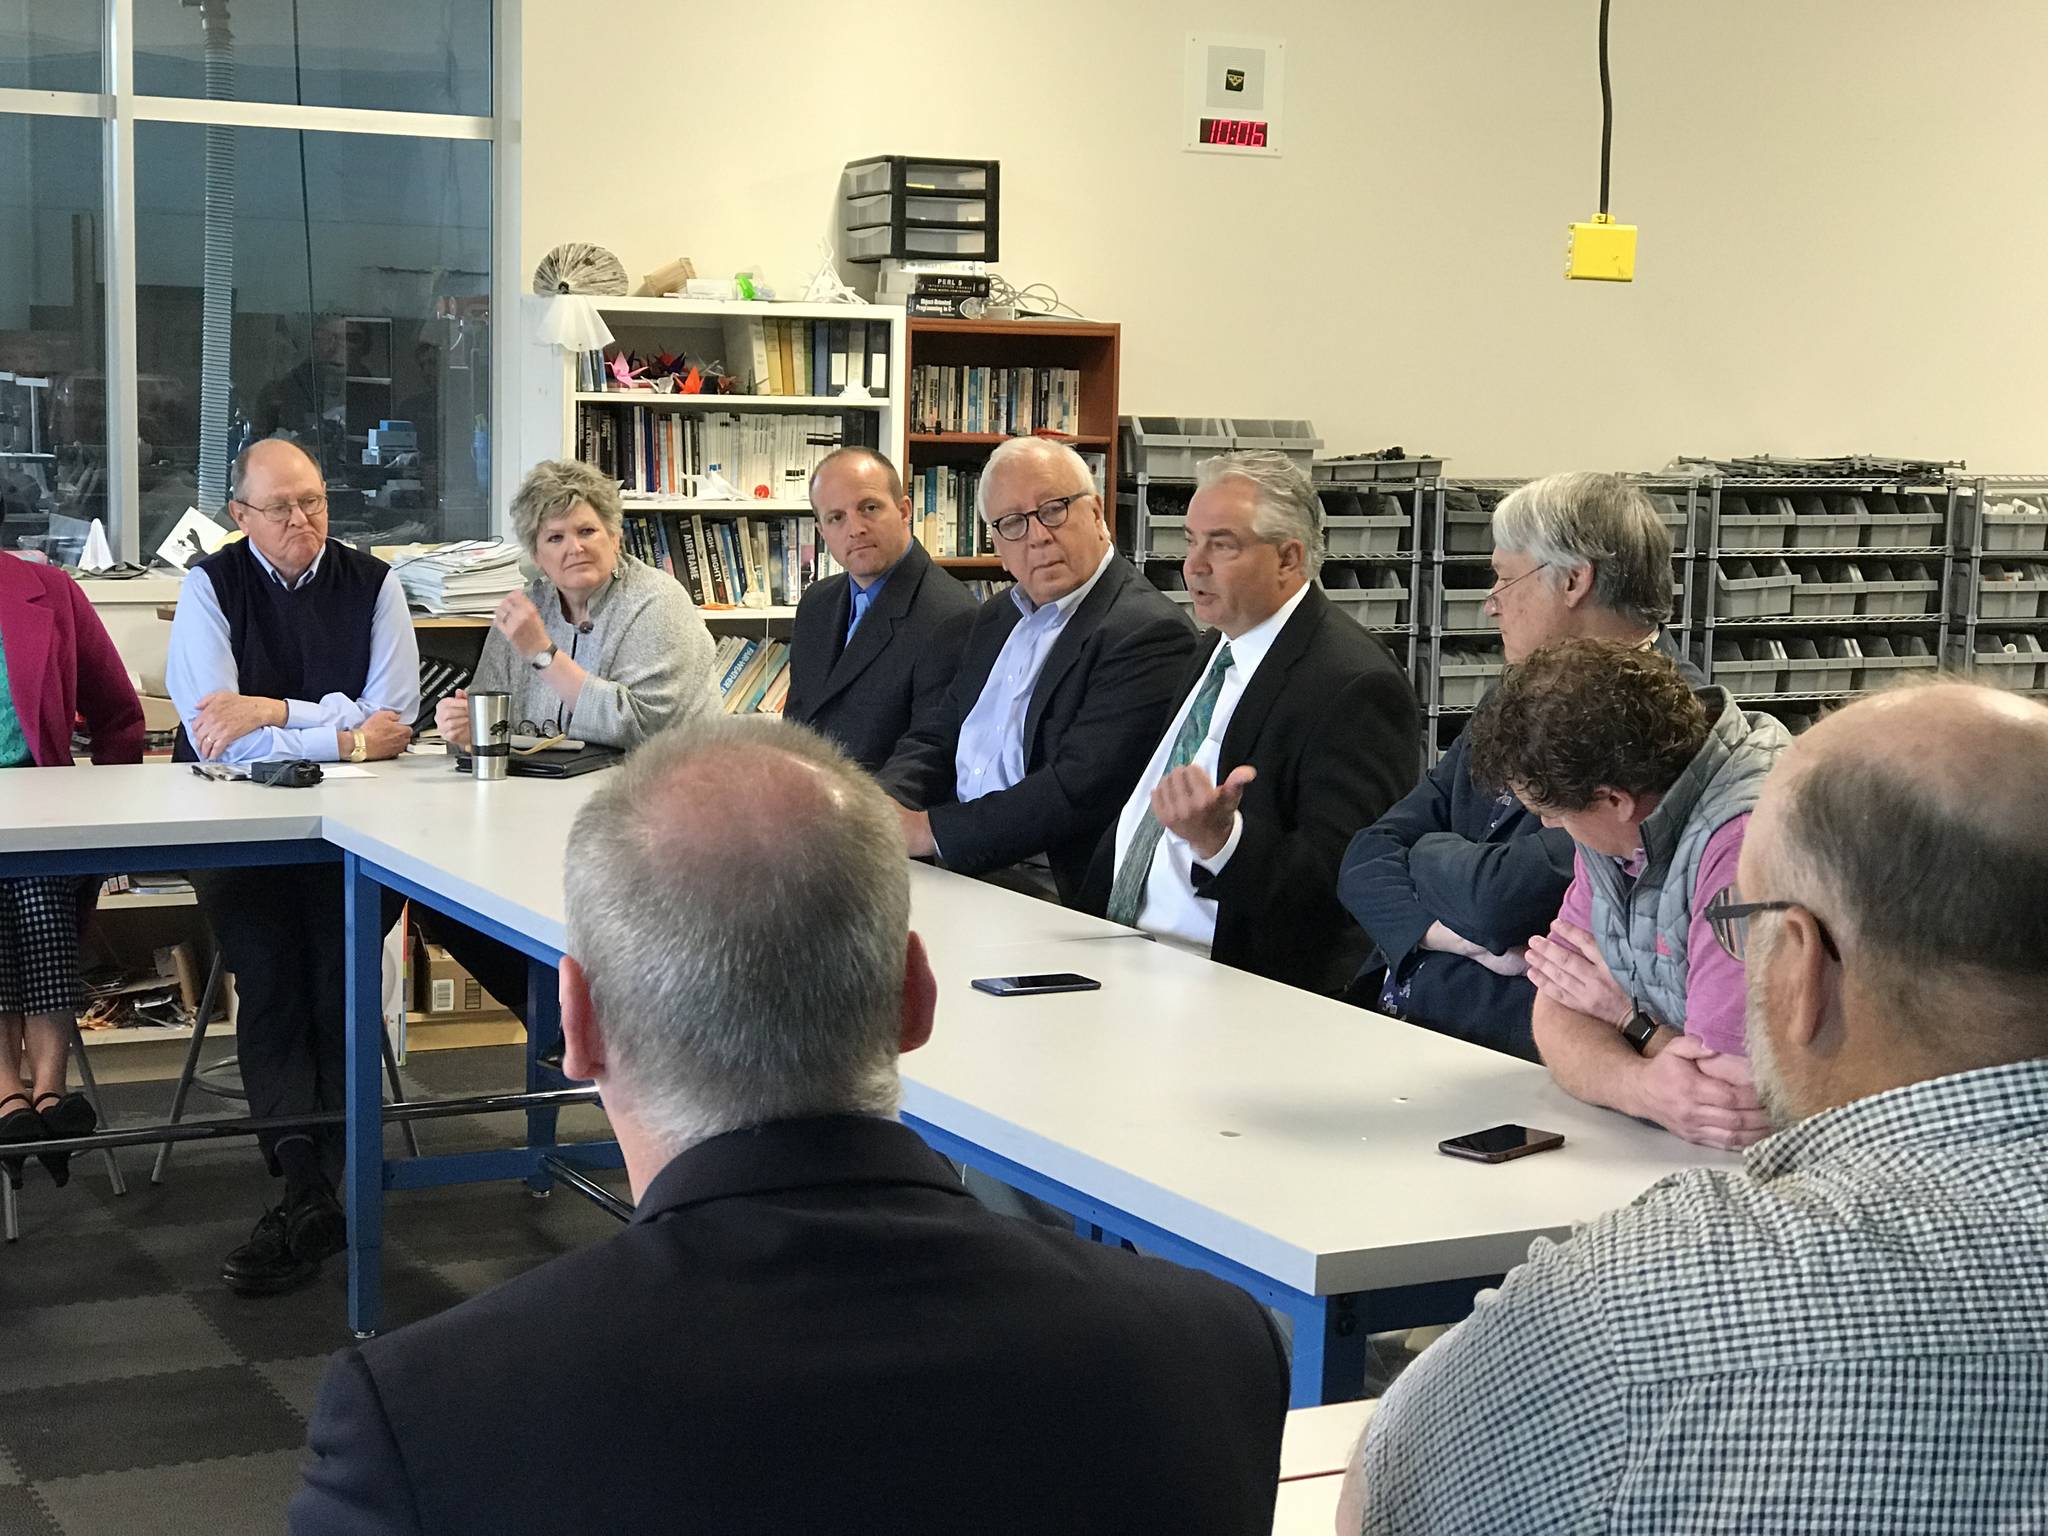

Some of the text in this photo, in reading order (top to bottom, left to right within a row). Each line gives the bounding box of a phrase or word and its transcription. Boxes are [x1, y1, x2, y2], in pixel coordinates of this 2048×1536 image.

[1209, 119, 1266, 147] 10:06
[683, 534, 699, 580] AIRFRAME
[705, 528, 715, 548] HIGH
[710, 553, 722, 583] MIGHTY
